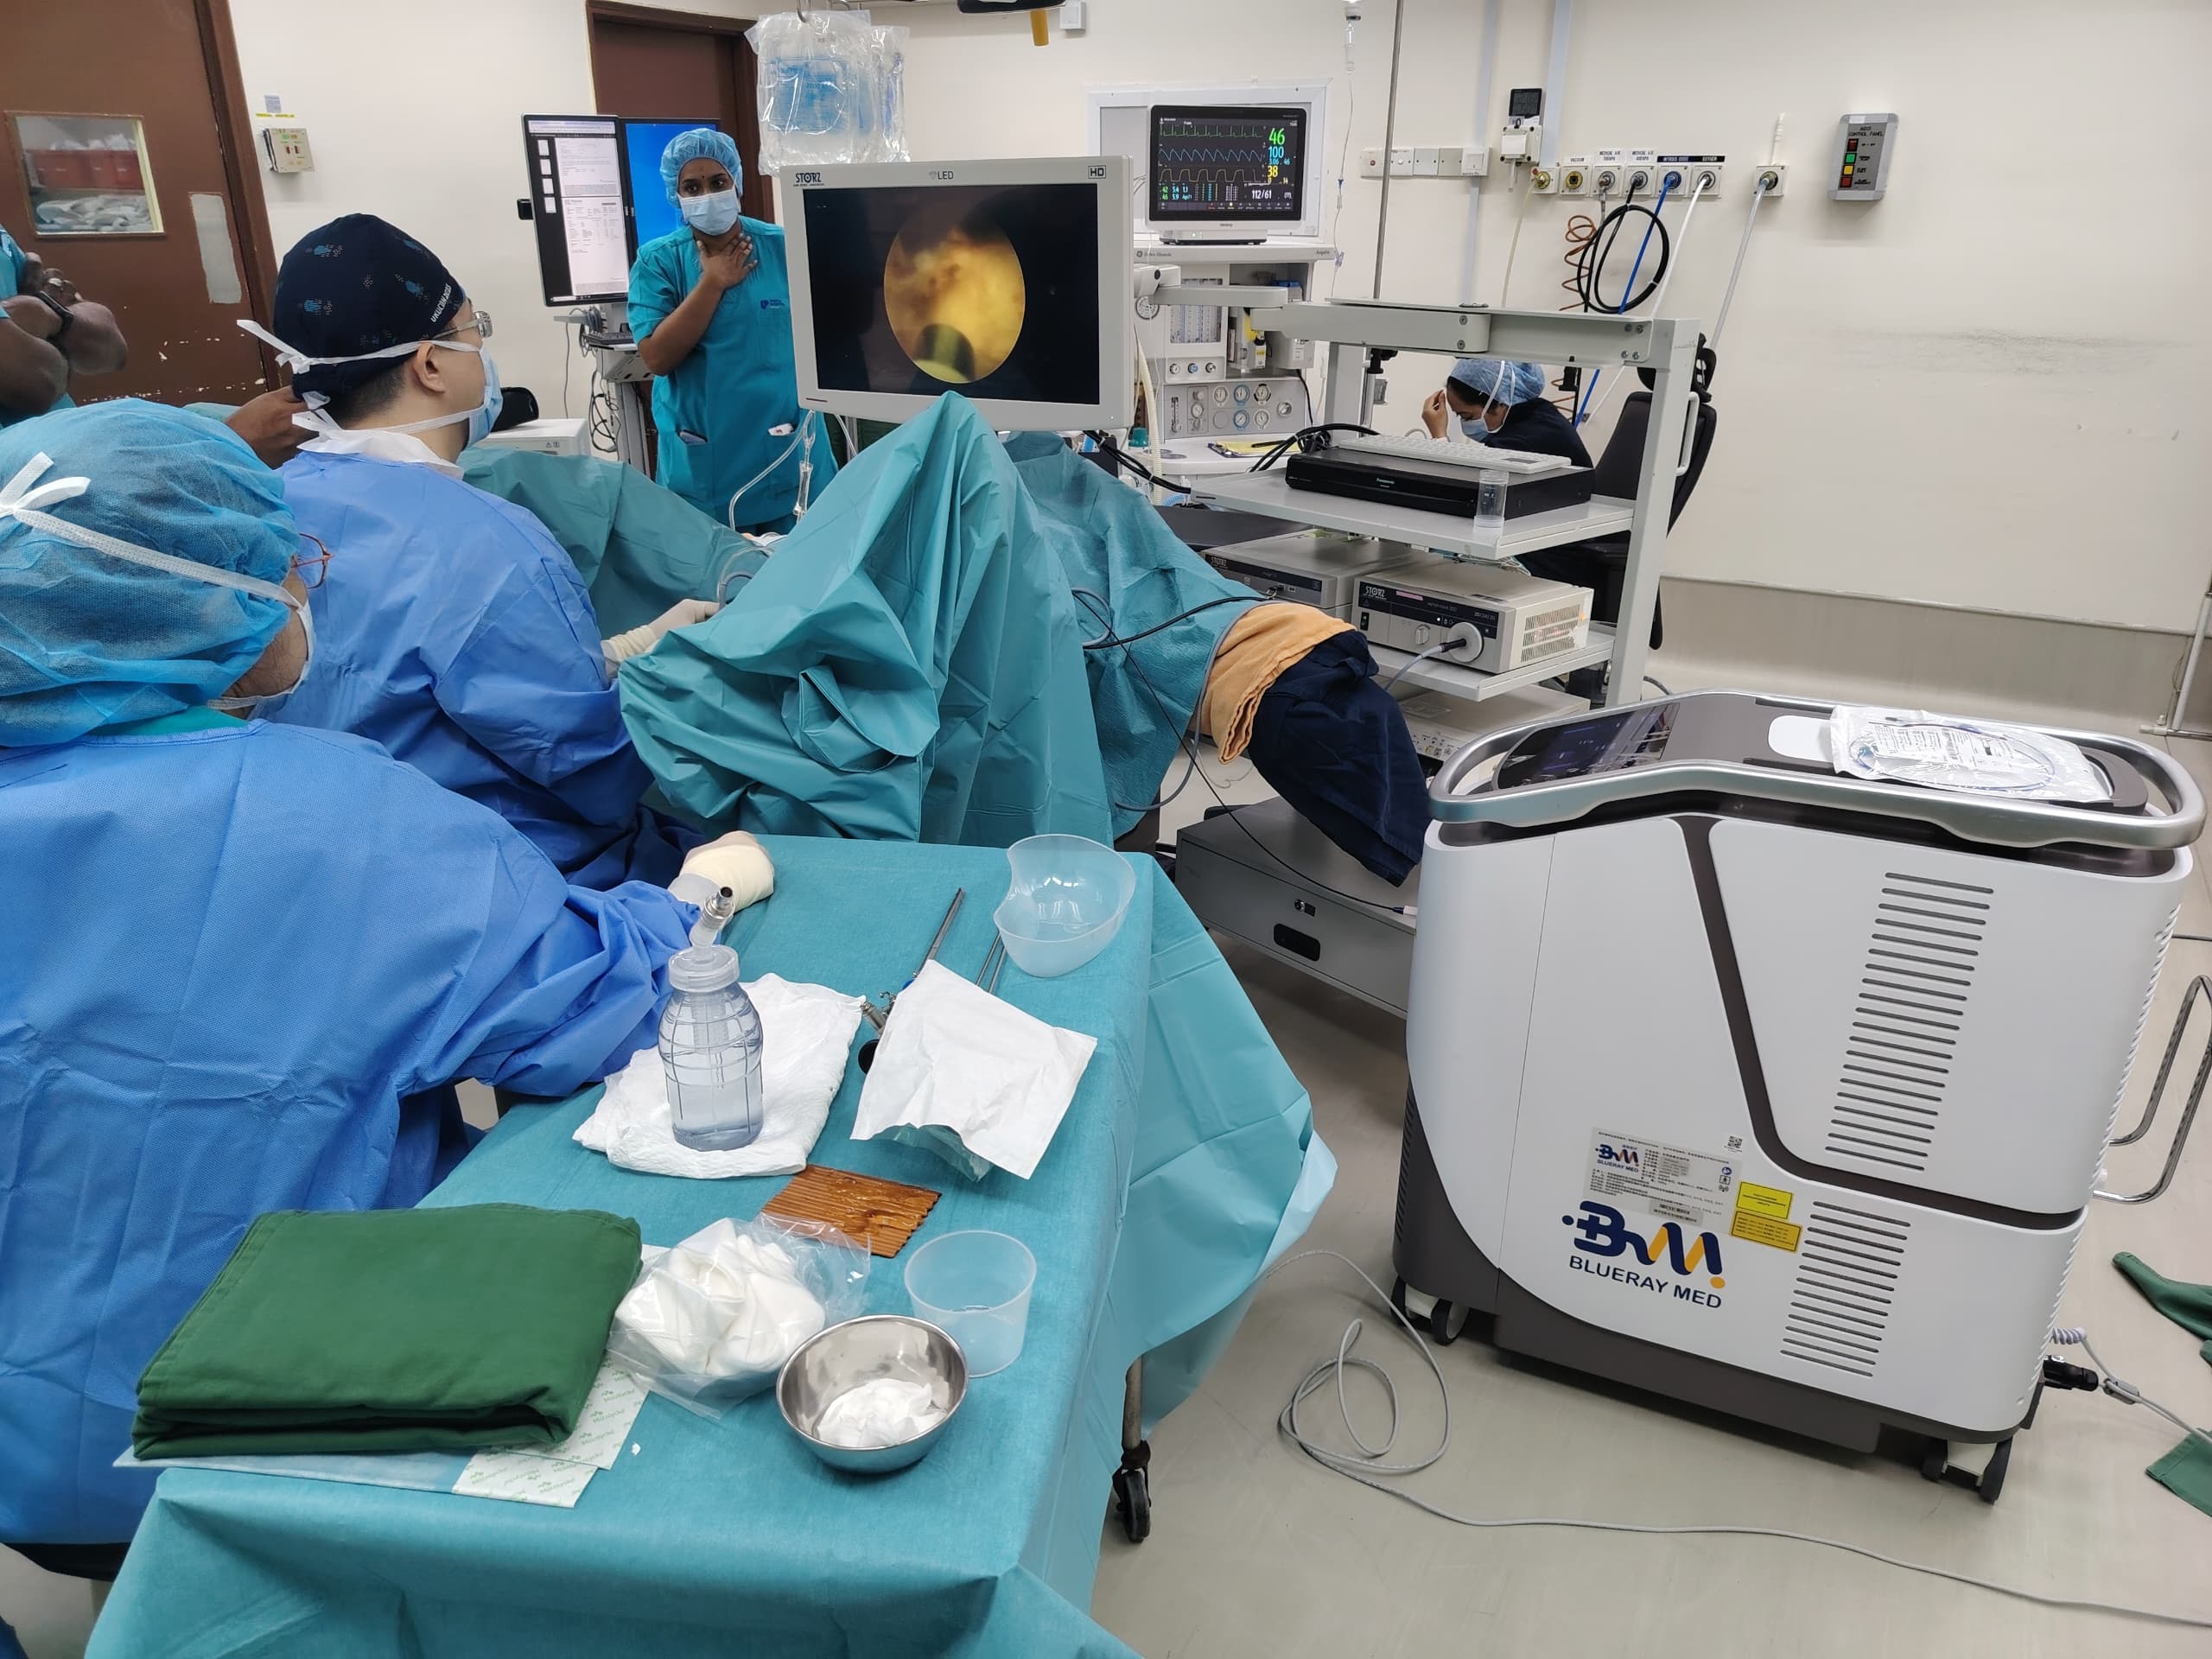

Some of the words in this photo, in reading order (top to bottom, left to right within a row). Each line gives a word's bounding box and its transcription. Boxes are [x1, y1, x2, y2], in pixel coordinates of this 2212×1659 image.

[1268, 127, 1285, 145] 46
[1268, 146, 1284, 158] 100
[938, 170, 954, 180] LED
[1090, 167, 1104, 177] HD
[1268, 165, 1278, 178] 38
[795, 172, 822, 183] STORZ
[1252, 189, 1272, 200] 112/61
[1365, 586, 1385, 598] STORZ
[1597, 1159, 1624, 1169] BLUERAY
[1569, 1255, 1669, 1294] BLUERAY
[1673, 1284, 1722, 1309] MED
